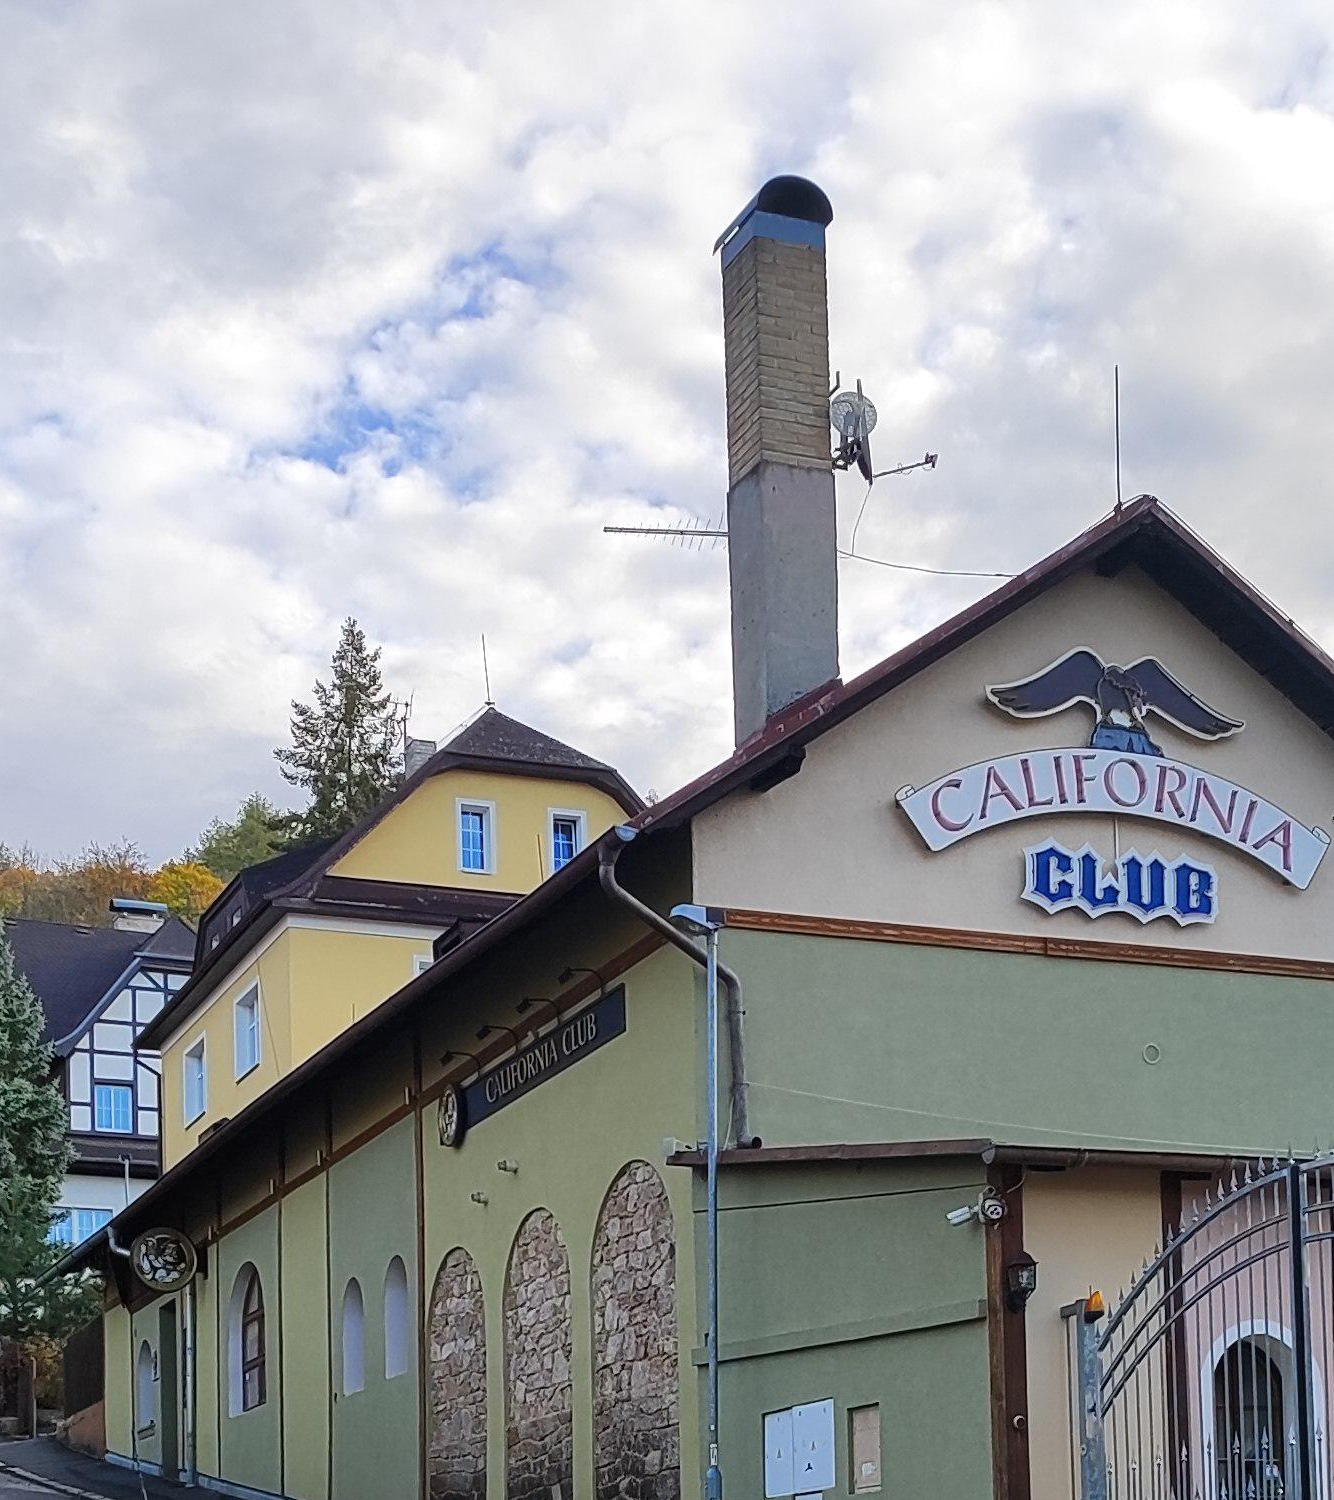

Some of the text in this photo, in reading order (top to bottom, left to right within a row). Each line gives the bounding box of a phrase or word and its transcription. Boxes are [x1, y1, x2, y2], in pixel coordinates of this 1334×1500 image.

[930, 753, 1296, 873] CALIFORNIA
[1028, 843, 1217, 920] CLUB
[485, 1012, 597, 1103] CALIFORNIA CLUB
